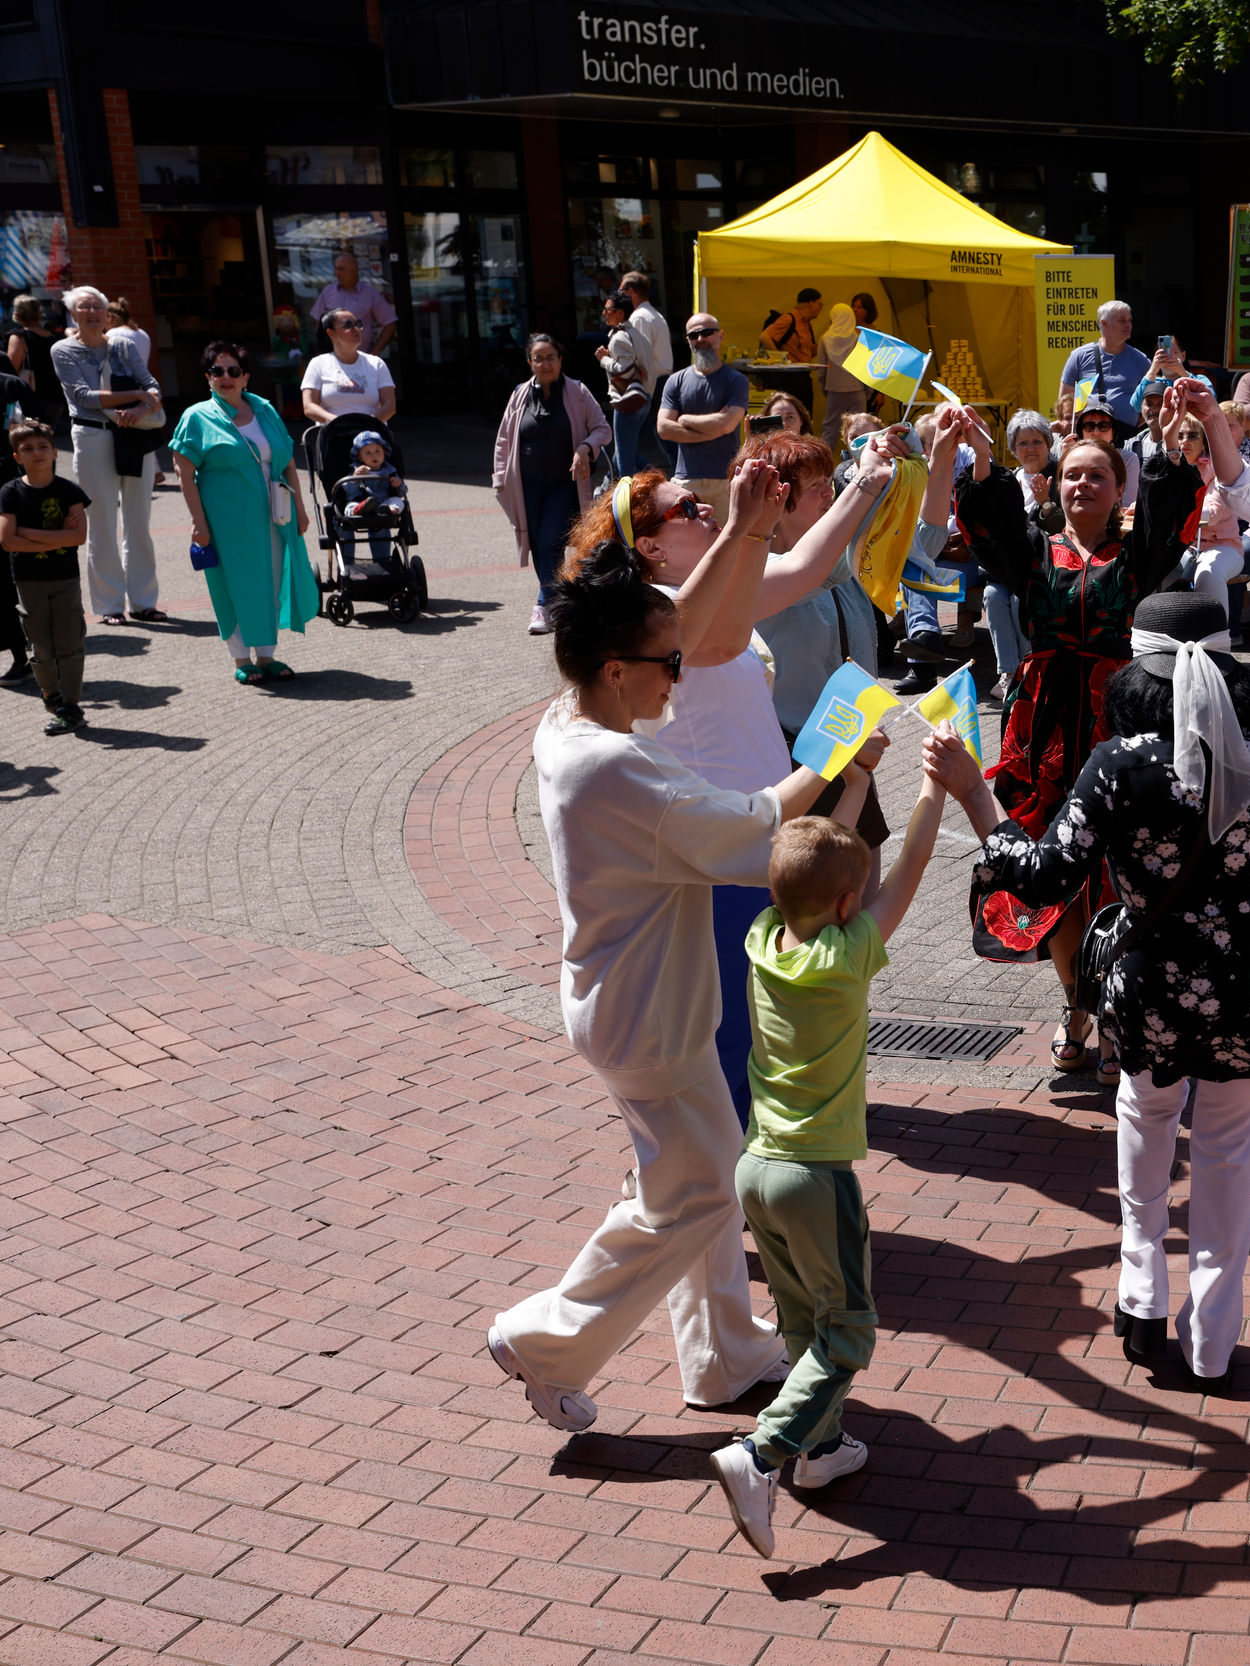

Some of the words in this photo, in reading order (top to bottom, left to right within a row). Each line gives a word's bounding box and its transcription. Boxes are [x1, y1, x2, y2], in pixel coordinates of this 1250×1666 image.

[577, 10, 706, 50] transfer.
[582, 49, 680, 88] bücher
[688, 61, 738, 92] und
[747, 67, 845, 99] medien.
[950, 250, 1003, 266] AMNESTY
[950, 265, 1003, 277] INTERNATIONAL
[1045, 271, 1072, 283] BITTE
[1046, 287, 1098, 299] EINTRETEN
[1047, 303, 1066, 315] FÜR
[1069, 304, 1085, 315] DIE
[1047, 320, 1100, 332] MENSCHEN
[1048, 337, 1085, 349] RECHTE
